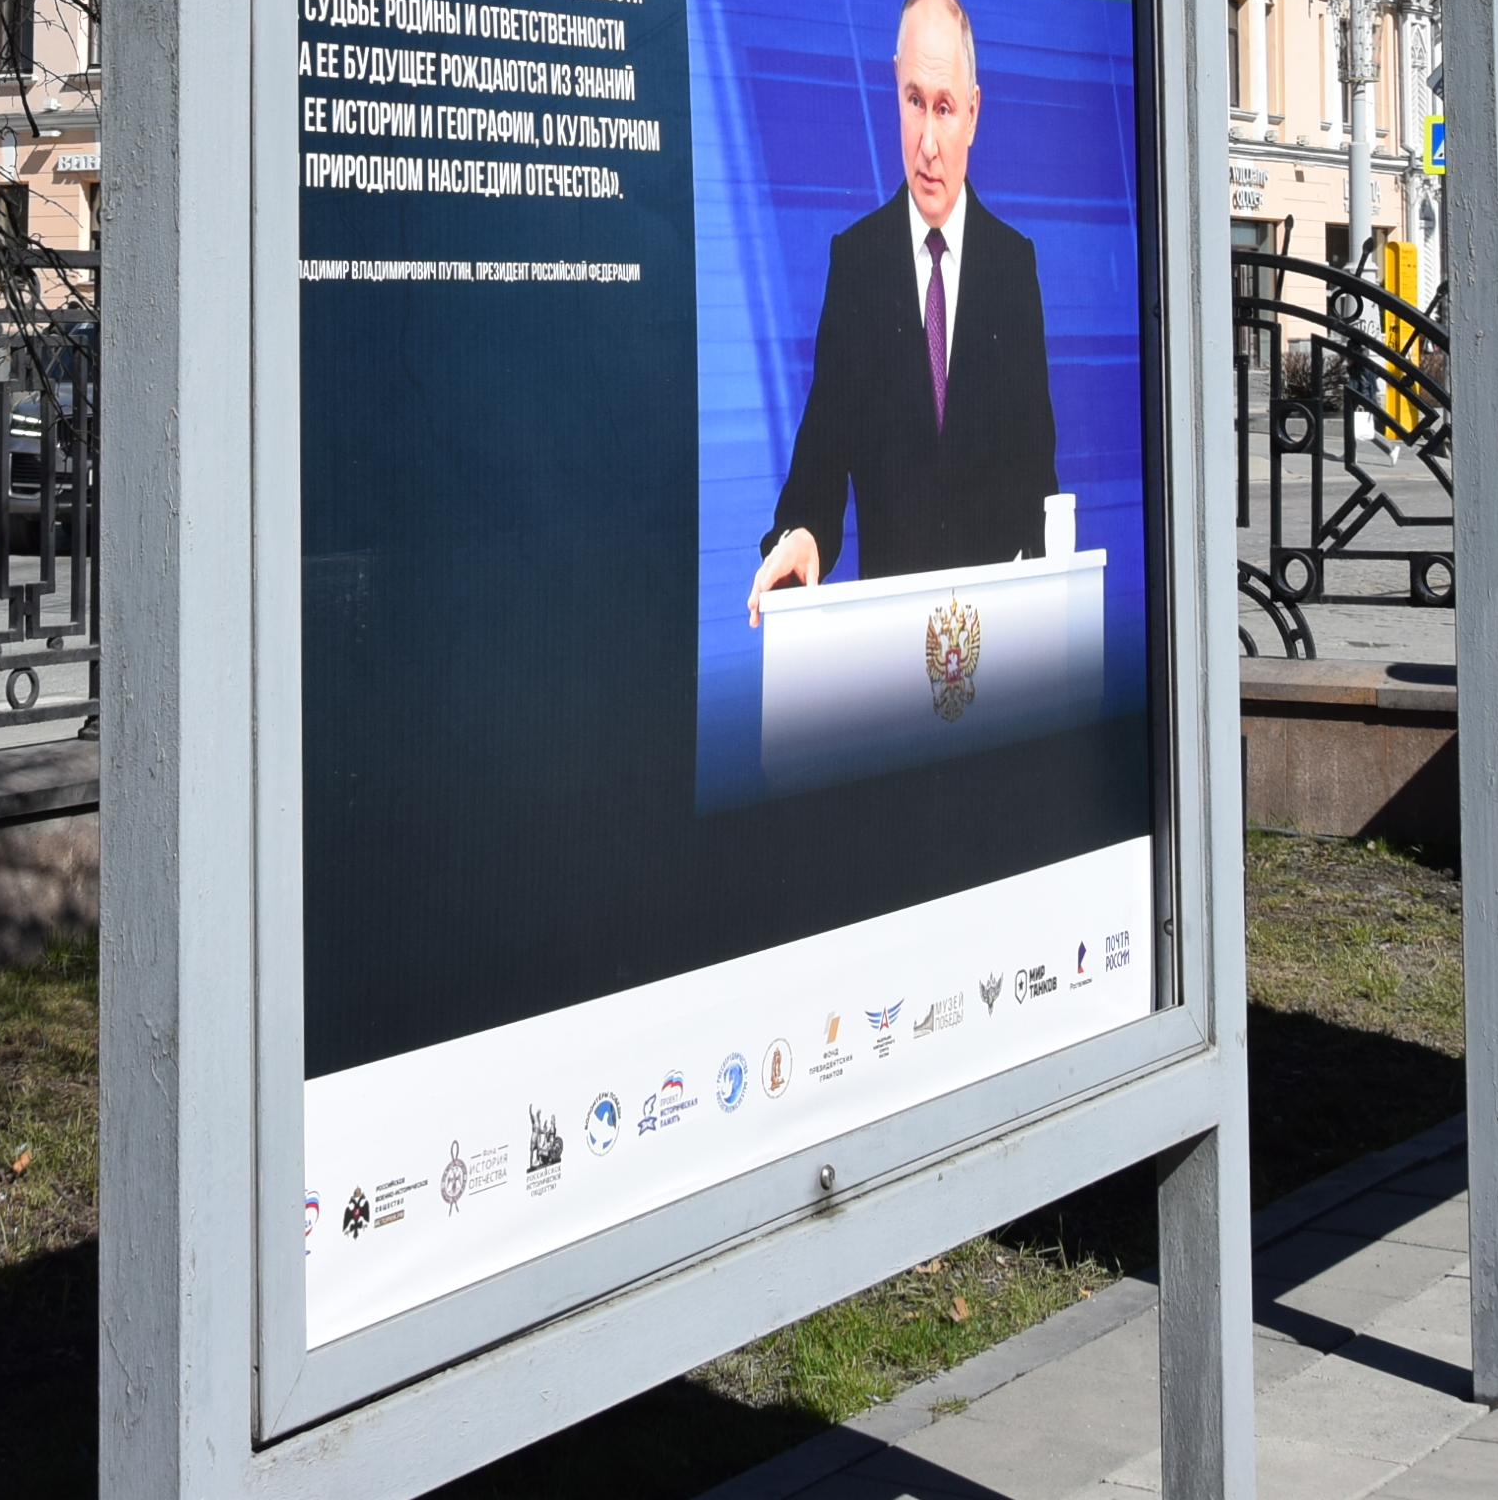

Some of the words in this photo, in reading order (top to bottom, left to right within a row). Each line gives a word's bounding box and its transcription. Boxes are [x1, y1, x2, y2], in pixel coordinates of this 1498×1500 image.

[464, 3, 477, 37] И
[480, 5, 625, 51] ОТВЕТСТВЕННОСТИ
[316, 42, 339, 79] ЕЕ
[343, 45, 437, 88] БУДУЩЕЕ
[441, 53, 548, 95] РОЖДАЮТСЯ
[551, 62, 572, 97] ИЗ
[575, 64, 636, 101] ЗНАНИЙ
[305, 96, 327, 133] ЕЕ
[332, 98, 416, 138] ИСТОРИИ
[421, 104, 433, 139] И
[437, 106, 540, 149] ГЕОГРАФИИ,
[543, 113, 554, 146] О
[557, 114, 660, 152] КУЛЬТУРНОМ
[306, 153, 423, 193] ПРИРОДНОМ
[427, 159, 522, 198] НАСЛЕДИИ
[525, 163, 624, 199] ОТЕЧЕСТВА».
[351, 260, 437, 282] ВЛАДИМИРОВИЧ
[438, 261, 474, 282] ПУТИН,
[476, 261, 530, 282] ПРЕЗИДЕНТ
[531, 260, 588, 282] РОССИЙСКОЙ
[588, 263, 640, 283] ФЕДЕРАЦИИ
[1105, 930, 1130, 954] ПОЧТА
[1029, 964, 1046, 983] МИР
[1029, 976, 1057, 999] ТАНКОВ
[935, 990, 964, 1015] МУЗЕЙ
[469, 1153, 508, 1175] ИСТОРИЯ
